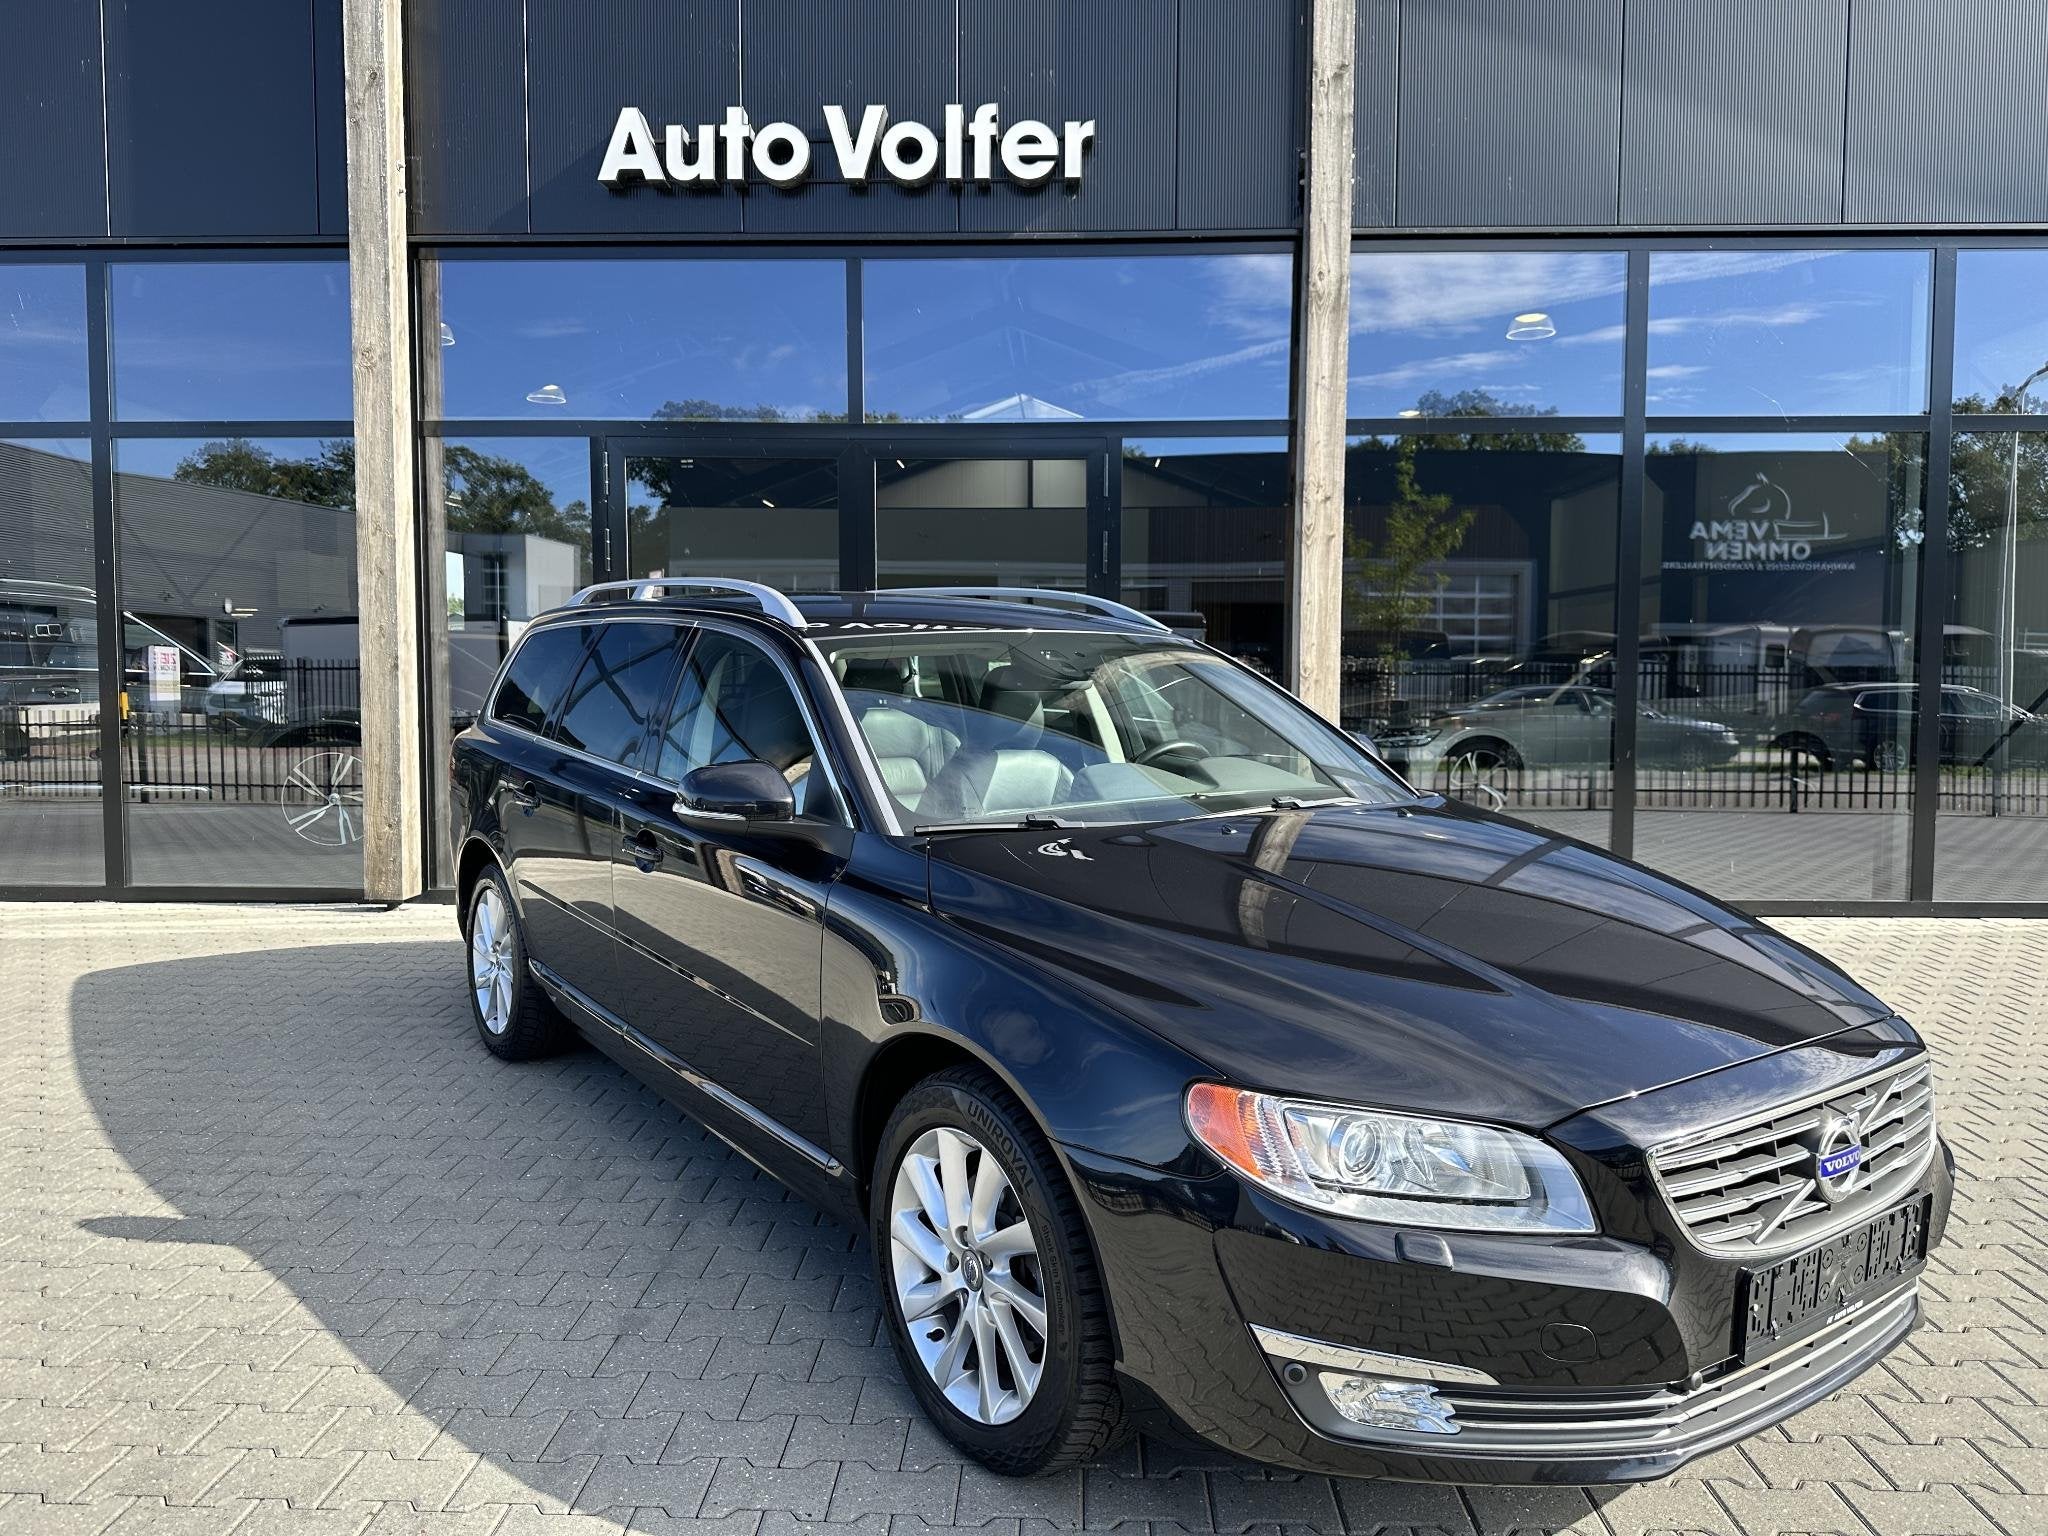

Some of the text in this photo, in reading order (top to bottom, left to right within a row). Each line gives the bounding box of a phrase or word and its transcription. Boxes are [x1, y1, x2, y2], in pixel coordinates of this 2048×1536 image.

[598, 102, 1095, 188] Auto Volfer
[967, 1100, 1035, 1198] UNIROYAL
[1824, 1150, 1860, 1172] VOLVO
